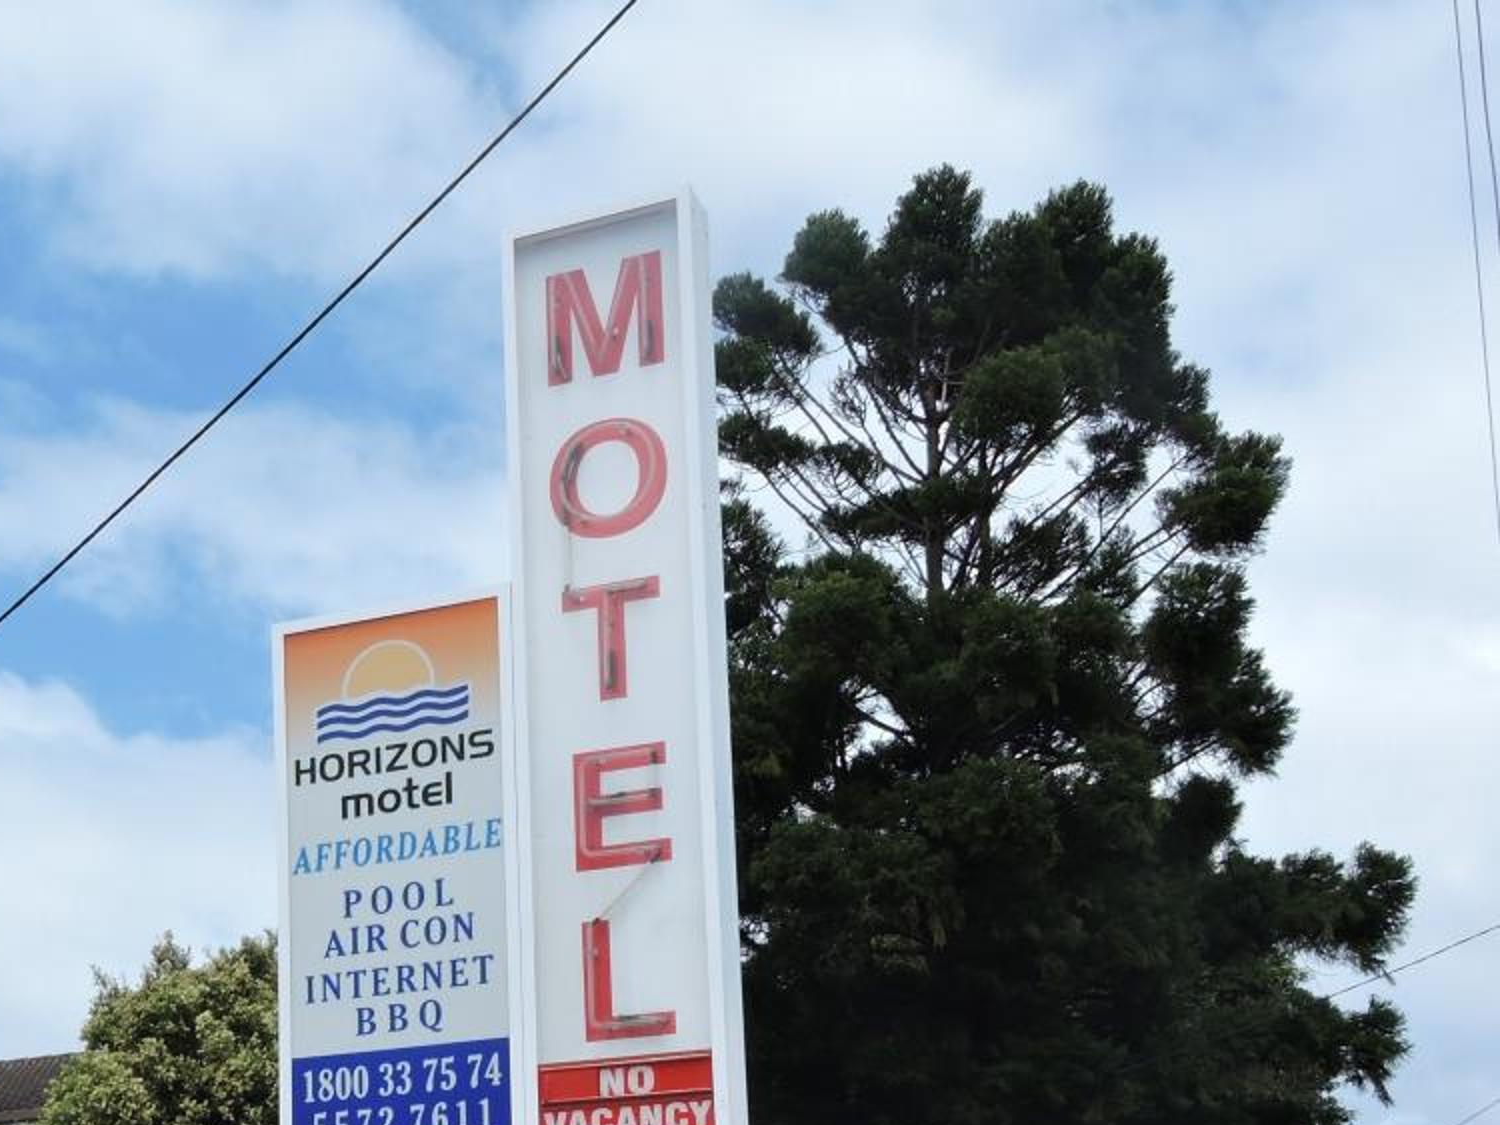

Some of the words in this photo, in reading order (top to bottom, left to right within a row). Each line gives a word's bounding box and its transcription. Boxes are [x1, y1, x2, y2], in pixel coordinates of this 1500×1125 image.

[545, 249, 677, 1043] MOTEL
[294, 728, 495, 787] HORIZONS
[341, 771, 453, 820] motel
[292, 817, 502, 876] AFFORDABLE
[343, 877, 454, 919] POOL
[323, 923, 388, 964] AIR
[399, 911, 474, 949] CON
[305, 953, 495, 1005] INTERNET
[355, 999, 443, 1037] BBQ
[303, 1065, 370, 1104] 1800
[378, 1060, 413, 1097] 33
[422, 1055, 458, 1093] 75
[466, 1051, 503, 1089] 74
[599, 1064, 656, 1099] NO
